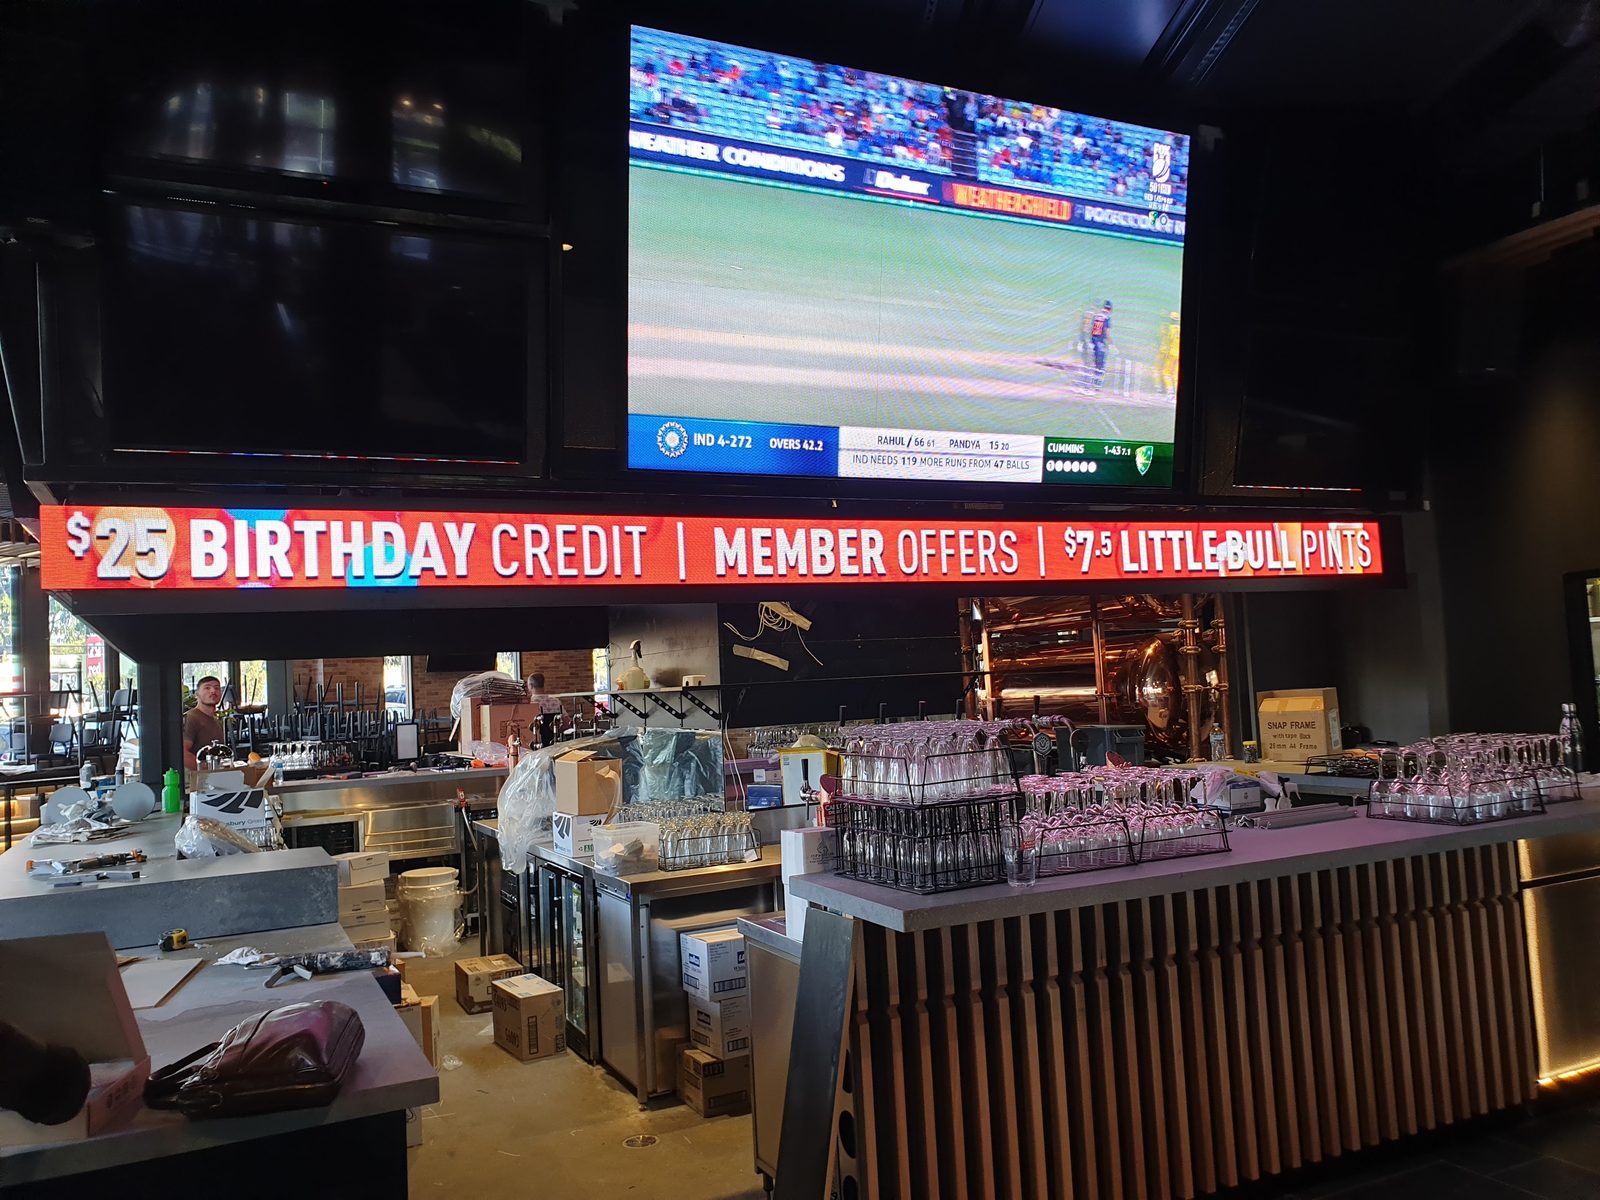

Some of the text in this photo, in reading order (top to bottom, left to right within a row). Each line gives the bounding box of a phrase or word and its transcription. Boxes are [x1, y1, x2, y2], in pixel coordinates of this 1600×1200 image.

[722, 146, 846, 183] CONDITIONS
[693, 432, 753, 449] IND 4-272
[769, 438, 824, 451] OVERS 42.2
[877, 435, 935, 448] RAHUL 66 61
[949, 438, 1010, 451] PANDYA 15 20
[1047, 443, 1085, 454] CUMMINS
[852, 454, 1030, 470] IND NEEDS 119 MORE RUNS FROM 47 BALLS
[66, 511, 648, 580] $25 BIRTHDAY CREDIT
[713, 527, 1019, 577] MEMBER OFFERS
[1120, 529, 1219, 573] LITTLE
[1225, 529, 1297, 571] BULL
[1302, 529, 1373, 568] PINTS
[1267, 721, 1316, 729] SNAP FRAME
